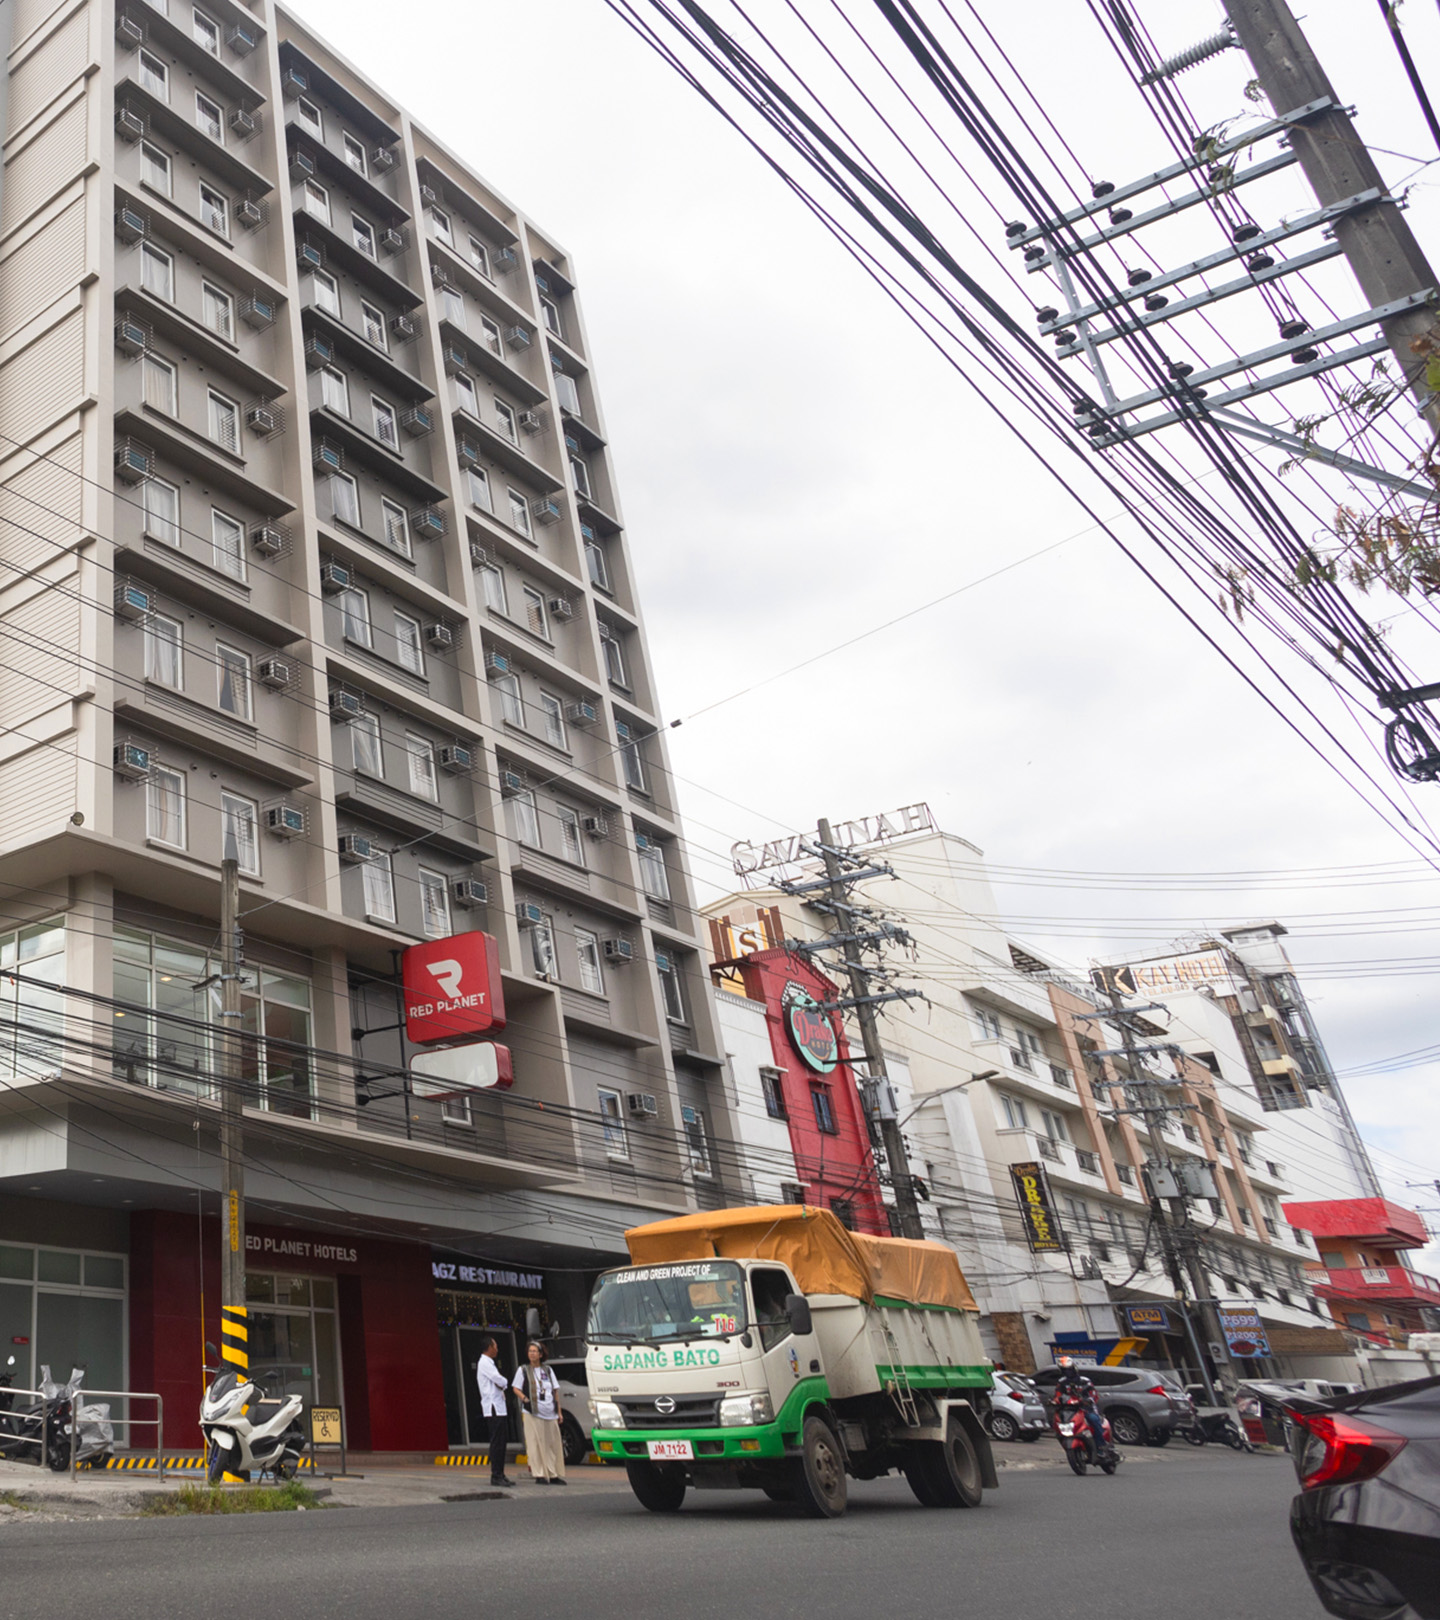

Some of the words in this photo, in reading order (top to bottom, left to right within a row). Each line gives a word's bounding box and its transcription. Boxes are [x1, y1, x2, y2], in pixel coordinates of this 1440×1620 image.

[1133, 965, 1173, 988] KAY
[1174, 956, 1229, 984] HOTEL
[410, 1003, 434, 1019] RED
[437, 993, 486, 1013] PLANET
[245, 1235, 262, 1250] ED
[264, 1238, 311, 1256] PLANET
[314, 1244, 358, 1262] HOTELS
[459, 1265, 543, 1290] RESTAURANT
[616, 1272, 636, 1284] CLEAN
[636, 1269, 649, 1281] AND
[649, 1267, 671, 1280] GREEN
[671, 1264, 700, 1278] PROJECT
[701, 1264, 711, 1275] OF
[714, 1318, 735, 1333] T16
[1133, 1310, 1159, 1319] ATM
[604, 1351, 668, 1371] SAPANG
[673, 1349, 720, 1367] BATO
[667, 1444, 687, 1455] 7122
